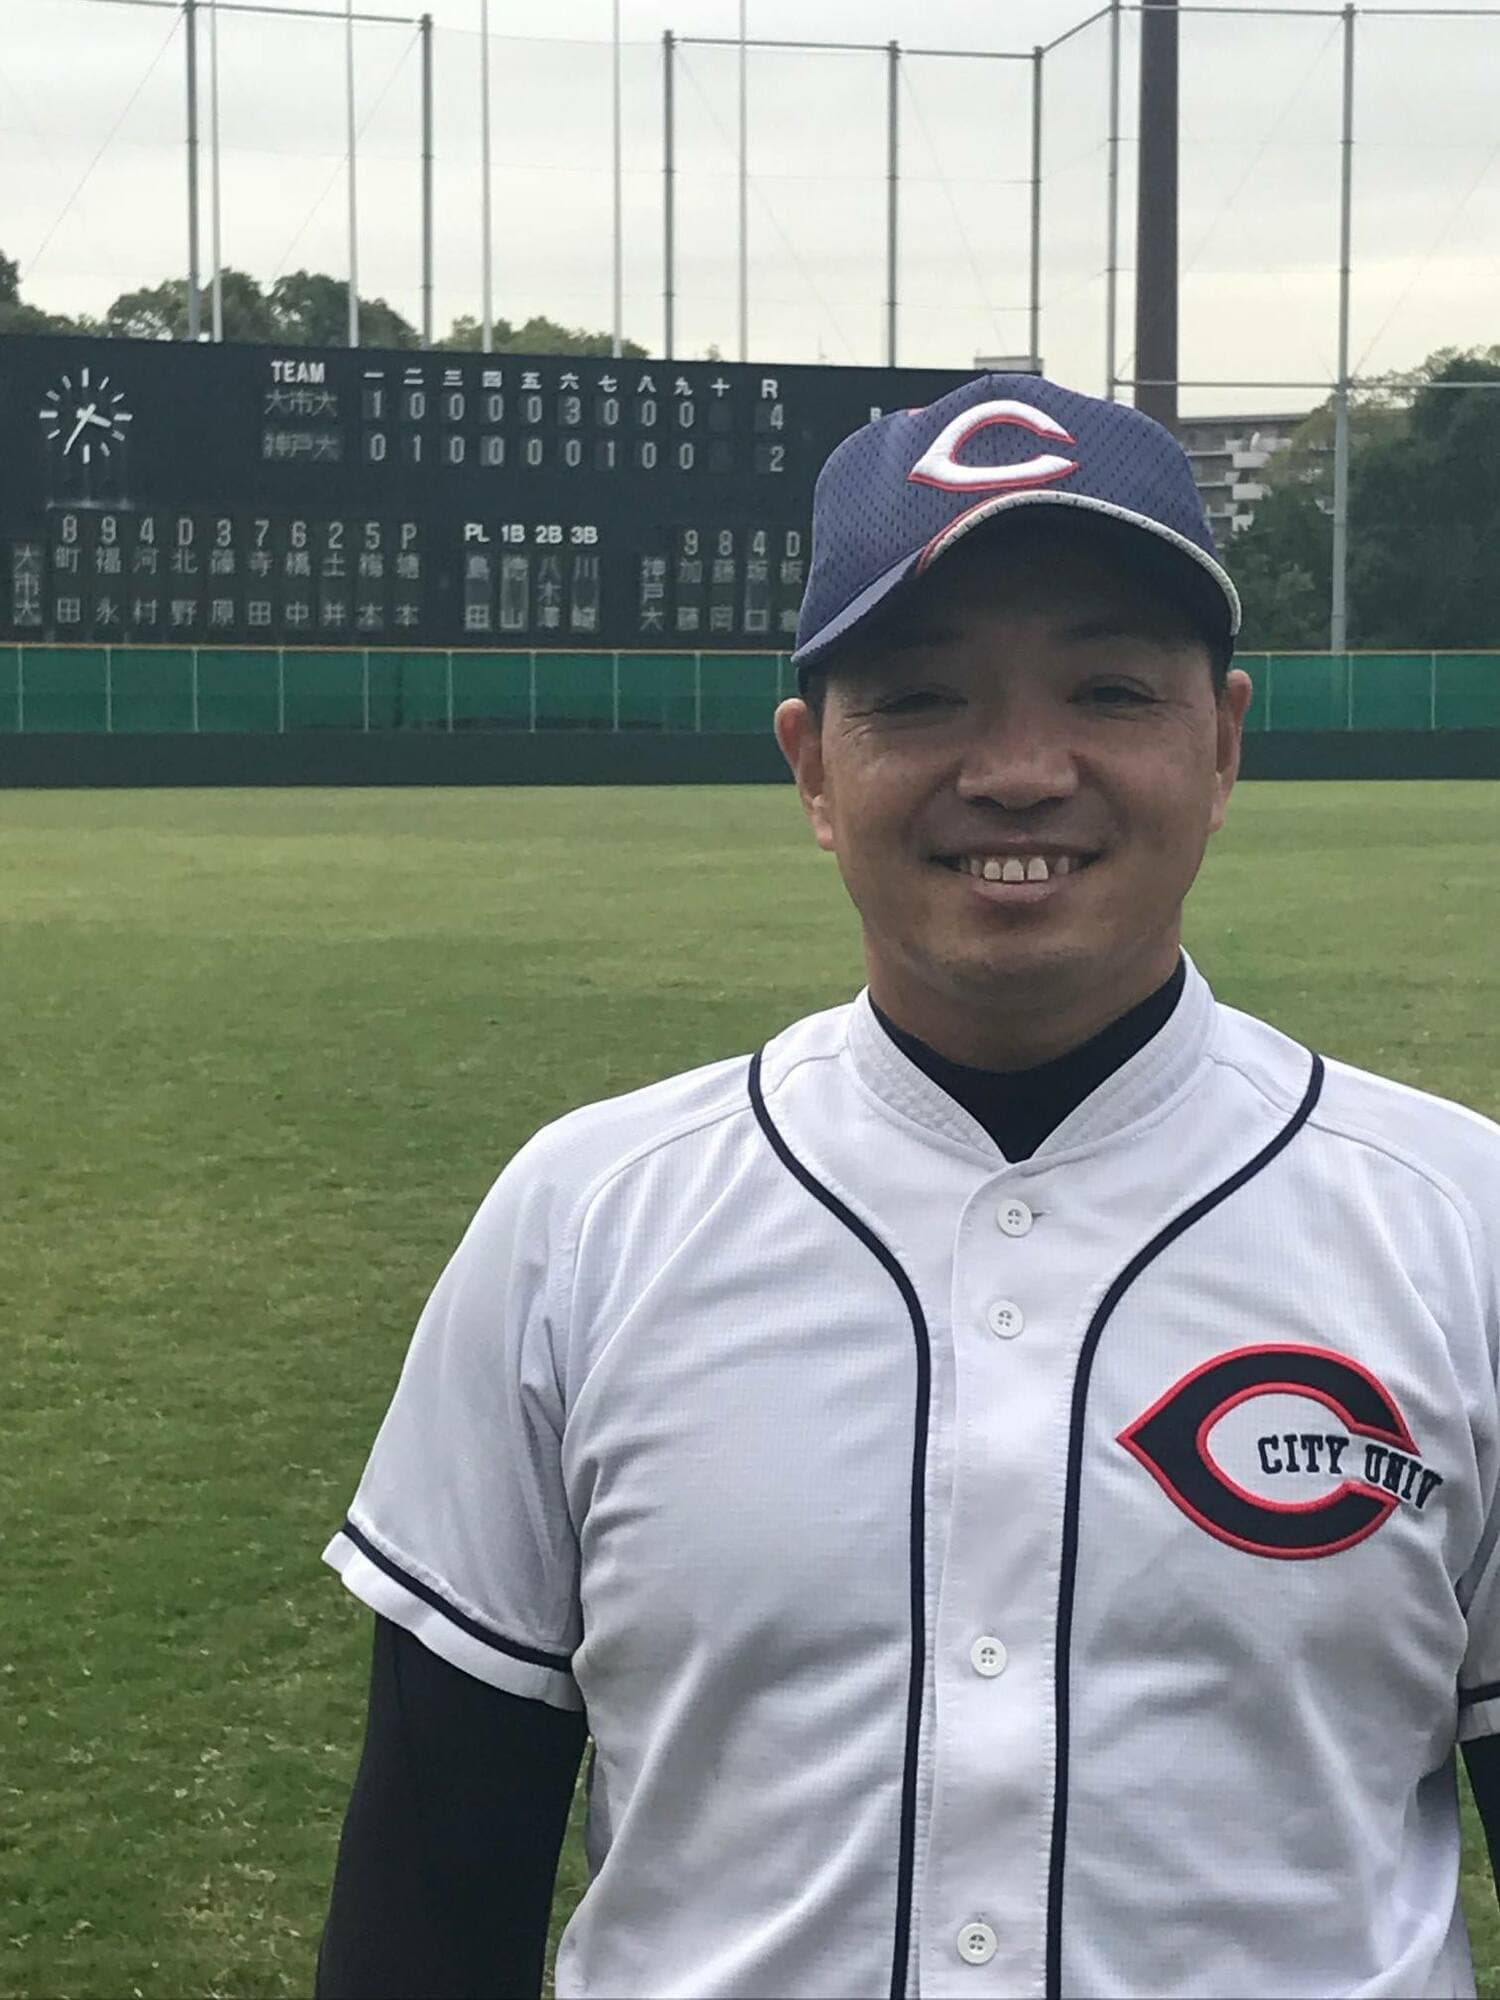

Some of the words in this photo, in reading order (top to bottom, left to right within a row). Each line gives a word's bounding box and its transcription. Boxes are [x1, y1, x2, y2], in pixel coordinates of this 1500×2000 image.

[270, 360, 325, 383] TEAM
[404, 368, 424, 384] 二
[443, 370, 463, 386] 三
[482, 370, 502, 387] 四
[521, 372, 541, 390] 五
[560, 372, 579, 390] 六
[598, 375, 618, 393] 七
[637, 375, 657, 393] 八
[674, 377, 693, 396] 九
[710, 378, 730, 397] 十
[264, 388, 338, 417] 大市大
[761, 379, 778, 399] R
[374, 390, 382, 418] 1
[410, 392, 425, 420] 0
[449, 393, 465, 421] 0
[488, 394, 504, 422] 0
[527, 396, 542, 423] 0
[565, 396, 581, 424] 3
[604, 398, 619, 425] 0
[641, 399, 657, 426] 0
[679, 401, 694, 428] 0
[770, 403, 783, 431] 4
[263, 433, 340, 460] 神戸大
[370, 433, 386, 461] 0
[413, 434, 421, 462] 1
[450, 436, 465, 463] 0
[489, 437, 504, 465] 0
[528, 438, 542, 466] 0
[566, 439, 581, 467] 0
[607, 441, 616, 468] 1
[642, 442, 657, 469] 0
[679, 443, 694, 470] 0
[769, 446, 783, 472] 2
[907, 399, 1080, 492] C
[62, 514, 77, 543] 8
[102, 515, 116, 544] 9
[140, 516, 154, 544] 4
[216, 518, 231, 547] 3
[254, 519, 269, 547] 7
[291, 520, 307, 548] 6
[328, 521, 344, 549] 2
[365, 521, 380, 549] 5
[401, 522, 417, 549] P
[464, 523, 490, 542] PL
[501, 524, 526, 543] 1B
[535, 525, 563, 544] 2B
[571, 526, 599, 544] 3B
[684, 529, 698, 556] 9
[718, 529, 733, 556] 8
[752, 530, 766, 557] 4
[1115, 1342, 1422, 1561] C
[1257, 1434, 1350, 1475] CITY
[1364, 1444, 1444, 1510] UNIV
